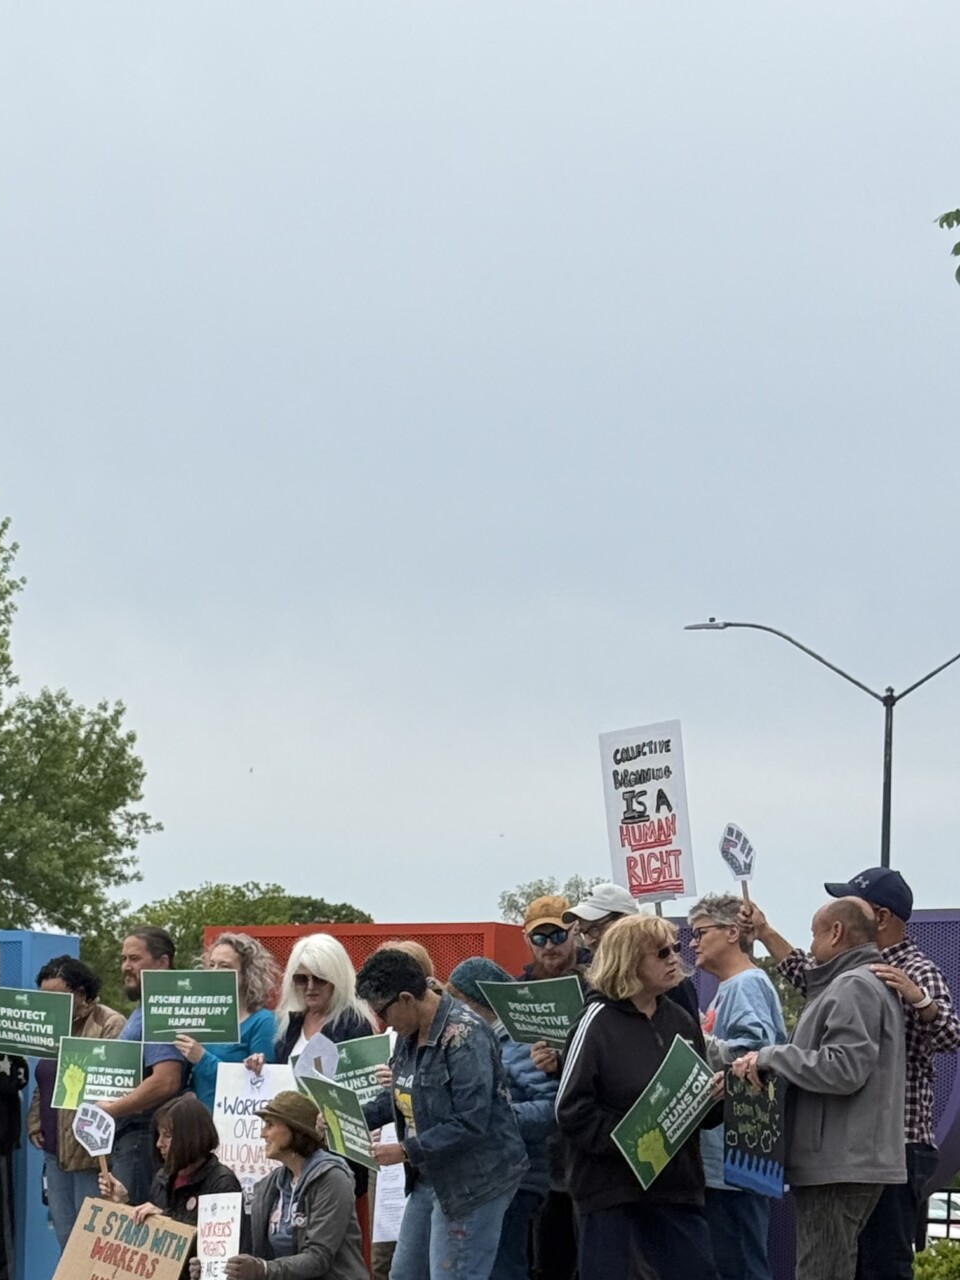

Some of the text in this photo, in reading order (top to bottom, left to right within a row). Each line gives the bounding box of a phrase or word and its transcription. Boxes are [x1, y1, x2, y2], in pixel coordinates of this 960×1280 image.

[613, 739, 672, 765] COLLECTIVE
[622, 788, 673, 820] IS A
[619, 813, 677, 848] HUMAN
[626, 849, 682, 885] RIGHT
[148, 995, 233, 1004] AFSCME MEMBERS
[507, 1001, 556, 1013] PROTECT
[0, 1007, 47, 1021] PROTECT
[150, 1006, 229, 1016] MAKE SALISBURY
[508, 1011, 571, 1026] COLLECTIVE
[168, 1017, 206, 1027] HAPPEN
[513, 1022, 568, 1038] BARGAININ
[86, 1073, 134, 1087] RUNS ON
[105, 1067, 136, 1076] SALISBURY
[368, 1074, 378, 1085] O
[676, 1062, 700, 1099] SALISBURY
[85, 1088, 131, 1098] UNION LABO
[661, 1070, 709, 1131] RUNS ON
[223, 1096, 272, 1116] WORKE
[234, 1118, 261, 1139] OVE
[668, 1109, 693, 1140] UNION
[83, 1205, 189, 1262] I STAND WITH
[90, 1236, 160, 1280] WORKERS
